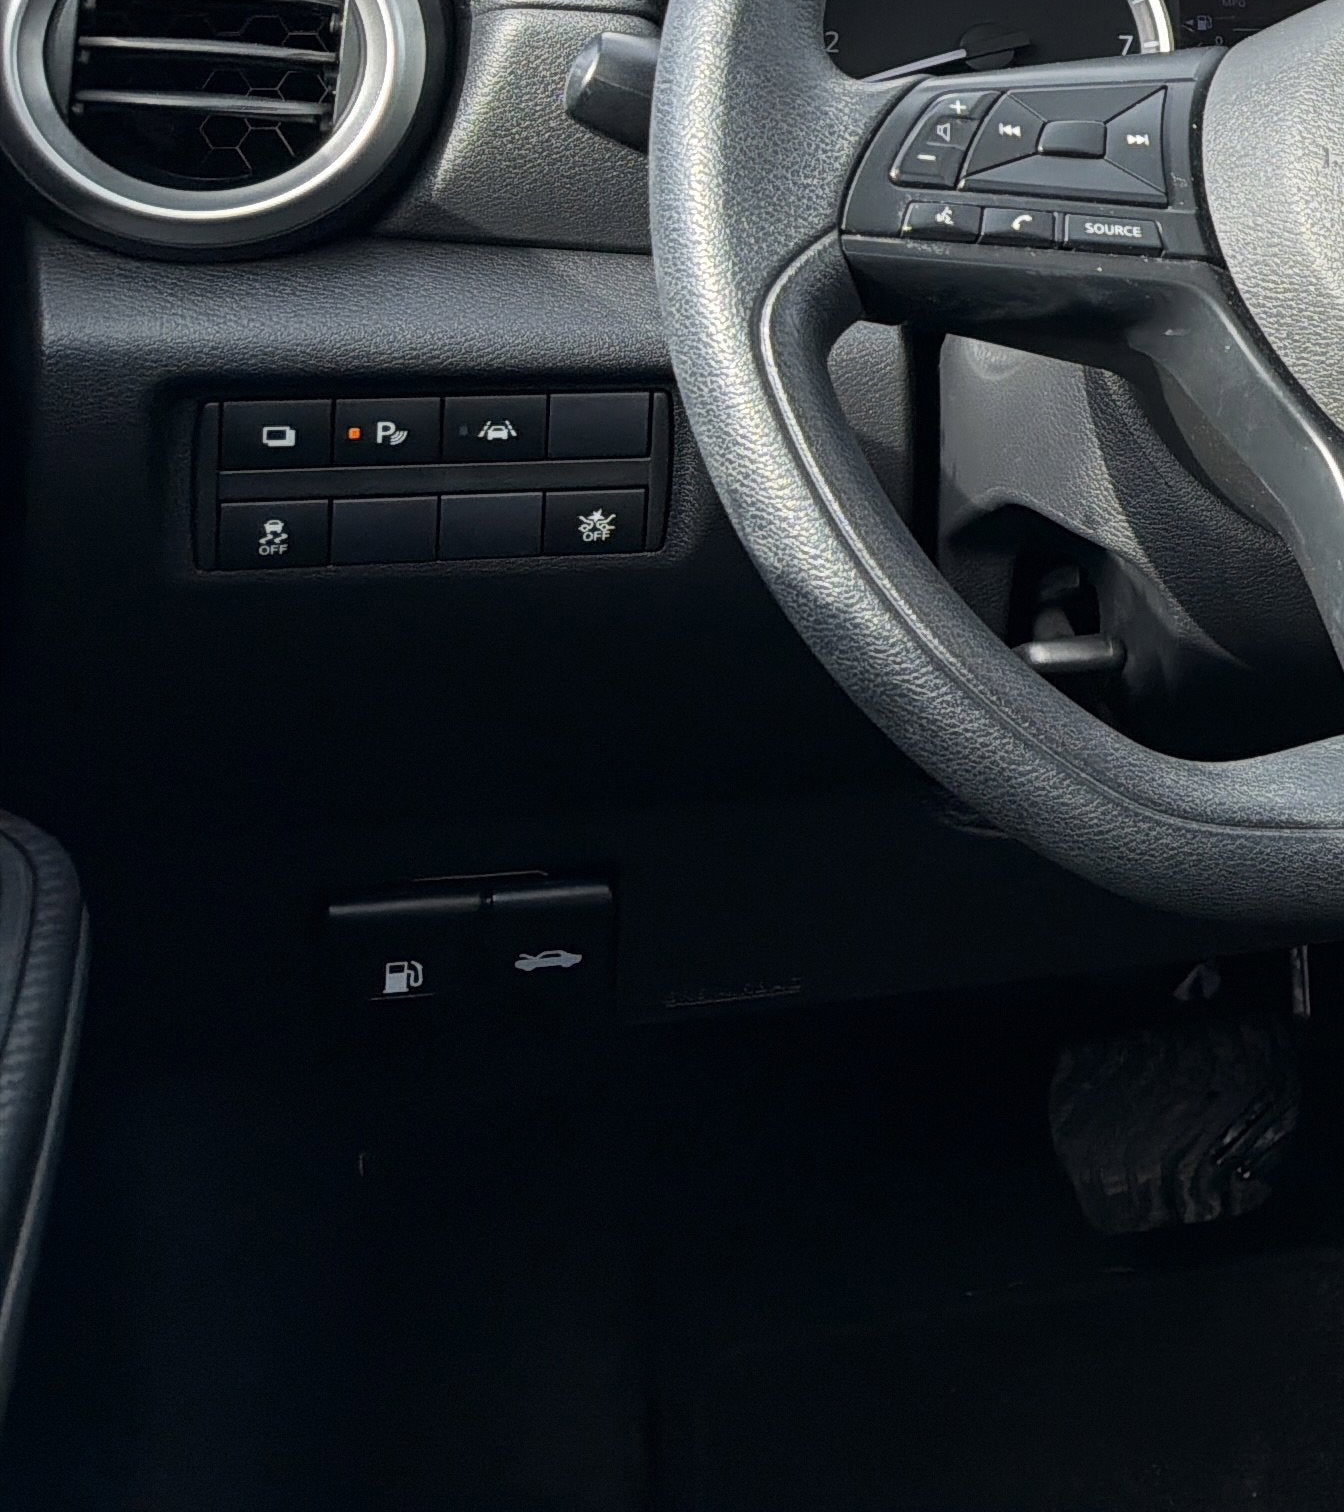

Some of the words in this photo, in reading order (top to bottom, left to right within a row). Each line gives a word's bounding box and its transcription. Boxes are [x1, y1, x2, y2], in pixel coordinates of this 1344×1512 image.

[825, 31, 841, 53] 2
[1118, 34, 1135, 57] 7
[1084, 222, 1142, 238] SOURCE
[582, 530, 610, 542] OFF
[258, 544, 288, 556] OFF
